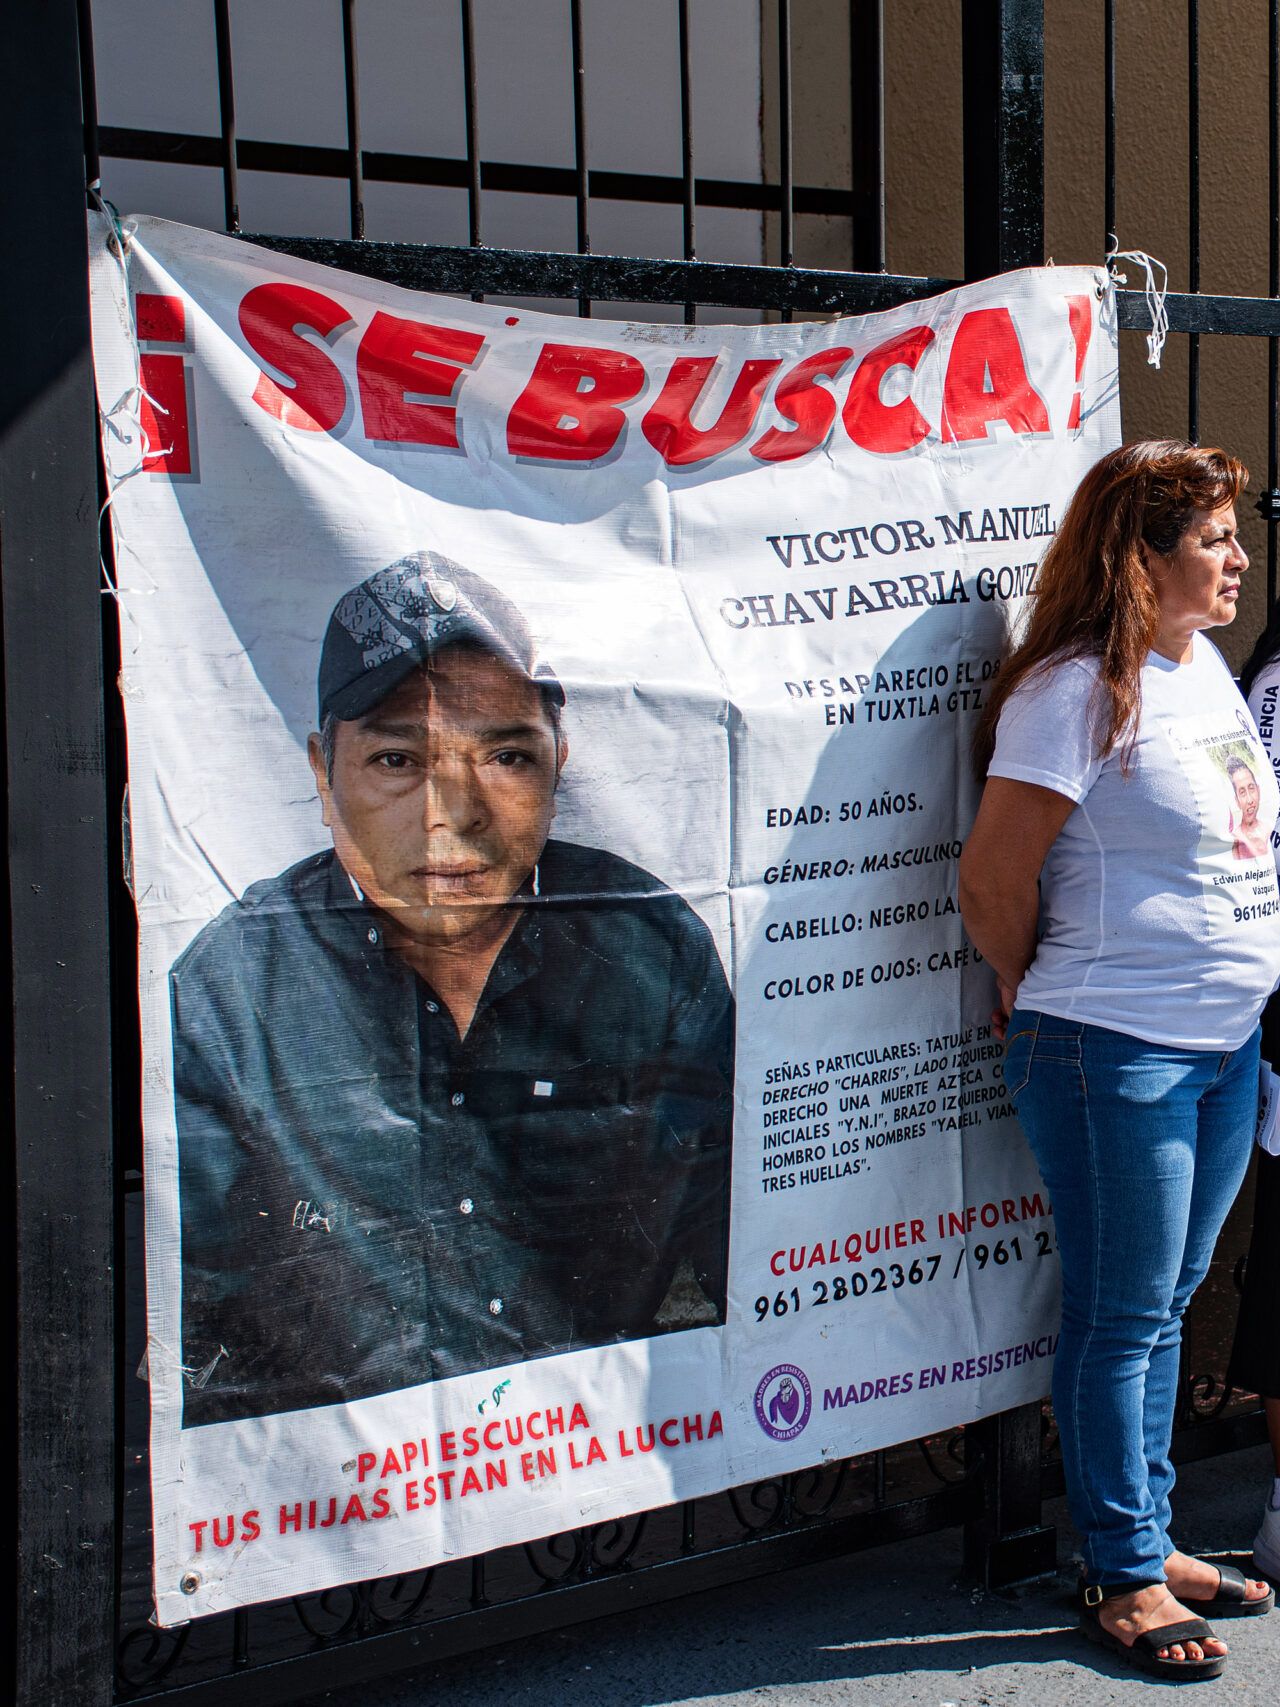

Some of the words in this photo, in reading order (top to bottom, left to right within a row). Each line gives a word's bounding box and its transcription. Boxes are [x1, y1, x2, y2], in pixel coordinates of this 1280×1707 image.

[766, 520, 935, 568] VICTOR
[935, 503, 1056, 546] MANUEL
[720, 569, 970, 629] CHAVARRIA
[785, 665, 949, 699] DESAPARECIO
[956, 662, 974, 683] EL
[826, 705, 854, 726] EN
[865, 694, 939, 722] TUXTLA
[766, 805, 831, 828] EDAD:
[838, 801, 862, 822] 50
[867, 790, 923, 818] AÑOS.
[763, 859, 855, 884] GÉNERO:
[860, 840, 963, 874] MASCULINO
[1212, 871, 1243, 886] Edwin
[765, 913, 863, 943] CABELLO:
[869, 900, 929, 929] NEGRO
[935, 896, 961, 917] LA
[764, 973, 835, 1000] COLOR
[842, 968, 864, 989] DE
[871, 957, 921, 983] OJOS:
[927, 942, 969, 972] CAFÉ
[762, 1081, 829, 1106] DERECHO
[913, 1056, 948, 1077] LADO
[952, 1043, 1005, 1068] IZQUIERD
[765, 1061, 811, 1085] SEÑAS
[816, 1041, 921, 1075] PARTICULARES:
[977, 1024, 991, 1041] EN
[763, 1104, 828, 1129] DERECHO
[839, 1094, 870, 1113] UNA
[881, 1081, 928, 1106] MUERTE
[763, 1122, 830, 1150] INICIALES
[893, 1099, 937, 1123] BRAZO
[942, 1084, 1007, 1112] IZQUIERDO
[762, 1145, 826, 1172] HOMBRO
[832, 1139, 860, 1158] LOS
[865, 1124, 926, 1151] NOMBRES
[762, 1173, 796, 1194] TRES
[770, 1219, 926, 1277] CUALQUIER
[754, 1287, 801, 1323] 961
[812, 1254, 942, 1307] 2802367
[953, 1248, 966, 1279] /
[974, 1236, 1023, 1270] 961
[1034, 1231, 1058, 1257] 2
[823, 1372, 914, 1411] MADRES
[918, 1365, 946, 1390] EN
[357, 1437, 430, 1483] PAPI
[440, 1402, 590, 1462] ESCUCHA
[772, 1423, 804, 1439] CHIAPAS
[189, 1509, 261, 1553] TUS
[279, 1487, 391, 1535] HIJAS
[406, 1461, 509, 1512] ESTAN
[520, 1448, 556, 1482] EN
[568, 1436, 607, 1469] LA
[619, 1410, 723, 1458] LUCHA
